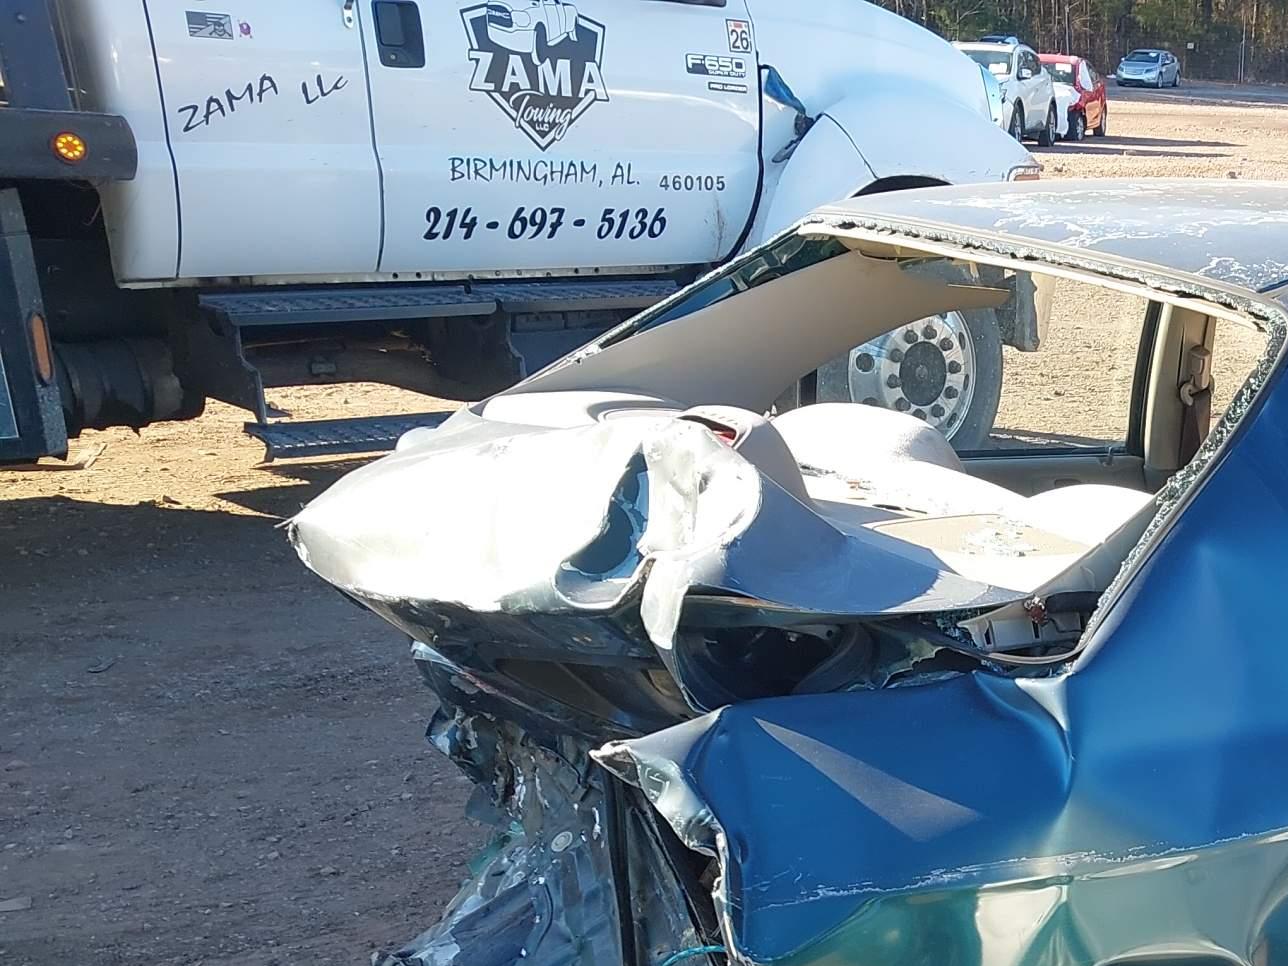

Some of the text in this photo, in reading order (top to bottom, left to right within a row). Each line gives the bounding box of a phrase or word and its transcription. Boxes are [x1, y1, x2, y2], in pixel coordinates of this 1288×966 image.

[730, 29, 749, 50] 26
[468, 49, 609, 102] ZAMA
[178, 73, 278, 133] ZAMA
[509, 90, 574, 141] Towing
[448, 156, 640, 188] BIRMINGHAM, AL.
[659, 175, 726, 192] 460105
